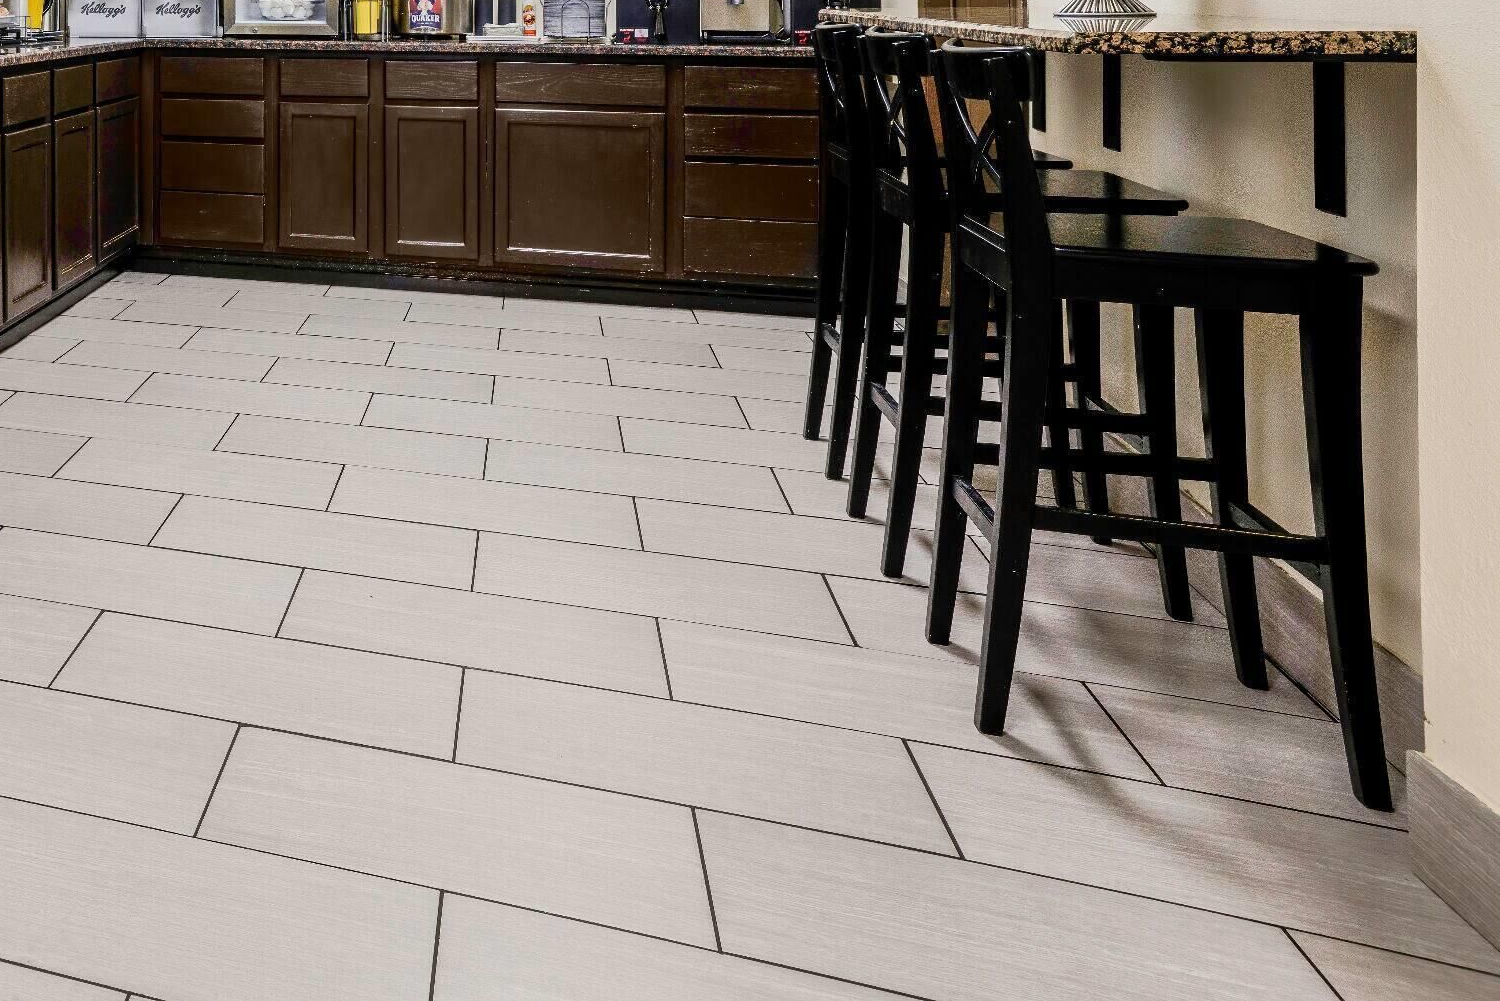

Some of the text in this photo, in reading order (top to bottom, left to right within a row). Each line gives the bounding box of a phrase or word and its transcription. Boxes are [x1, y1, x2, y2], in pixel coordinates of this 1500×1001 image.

[80, 1, 127, 18] Kellogg's
[155, 1, 201, 18] Kellogg's
[411, 14, 440, 23] QUAKER
